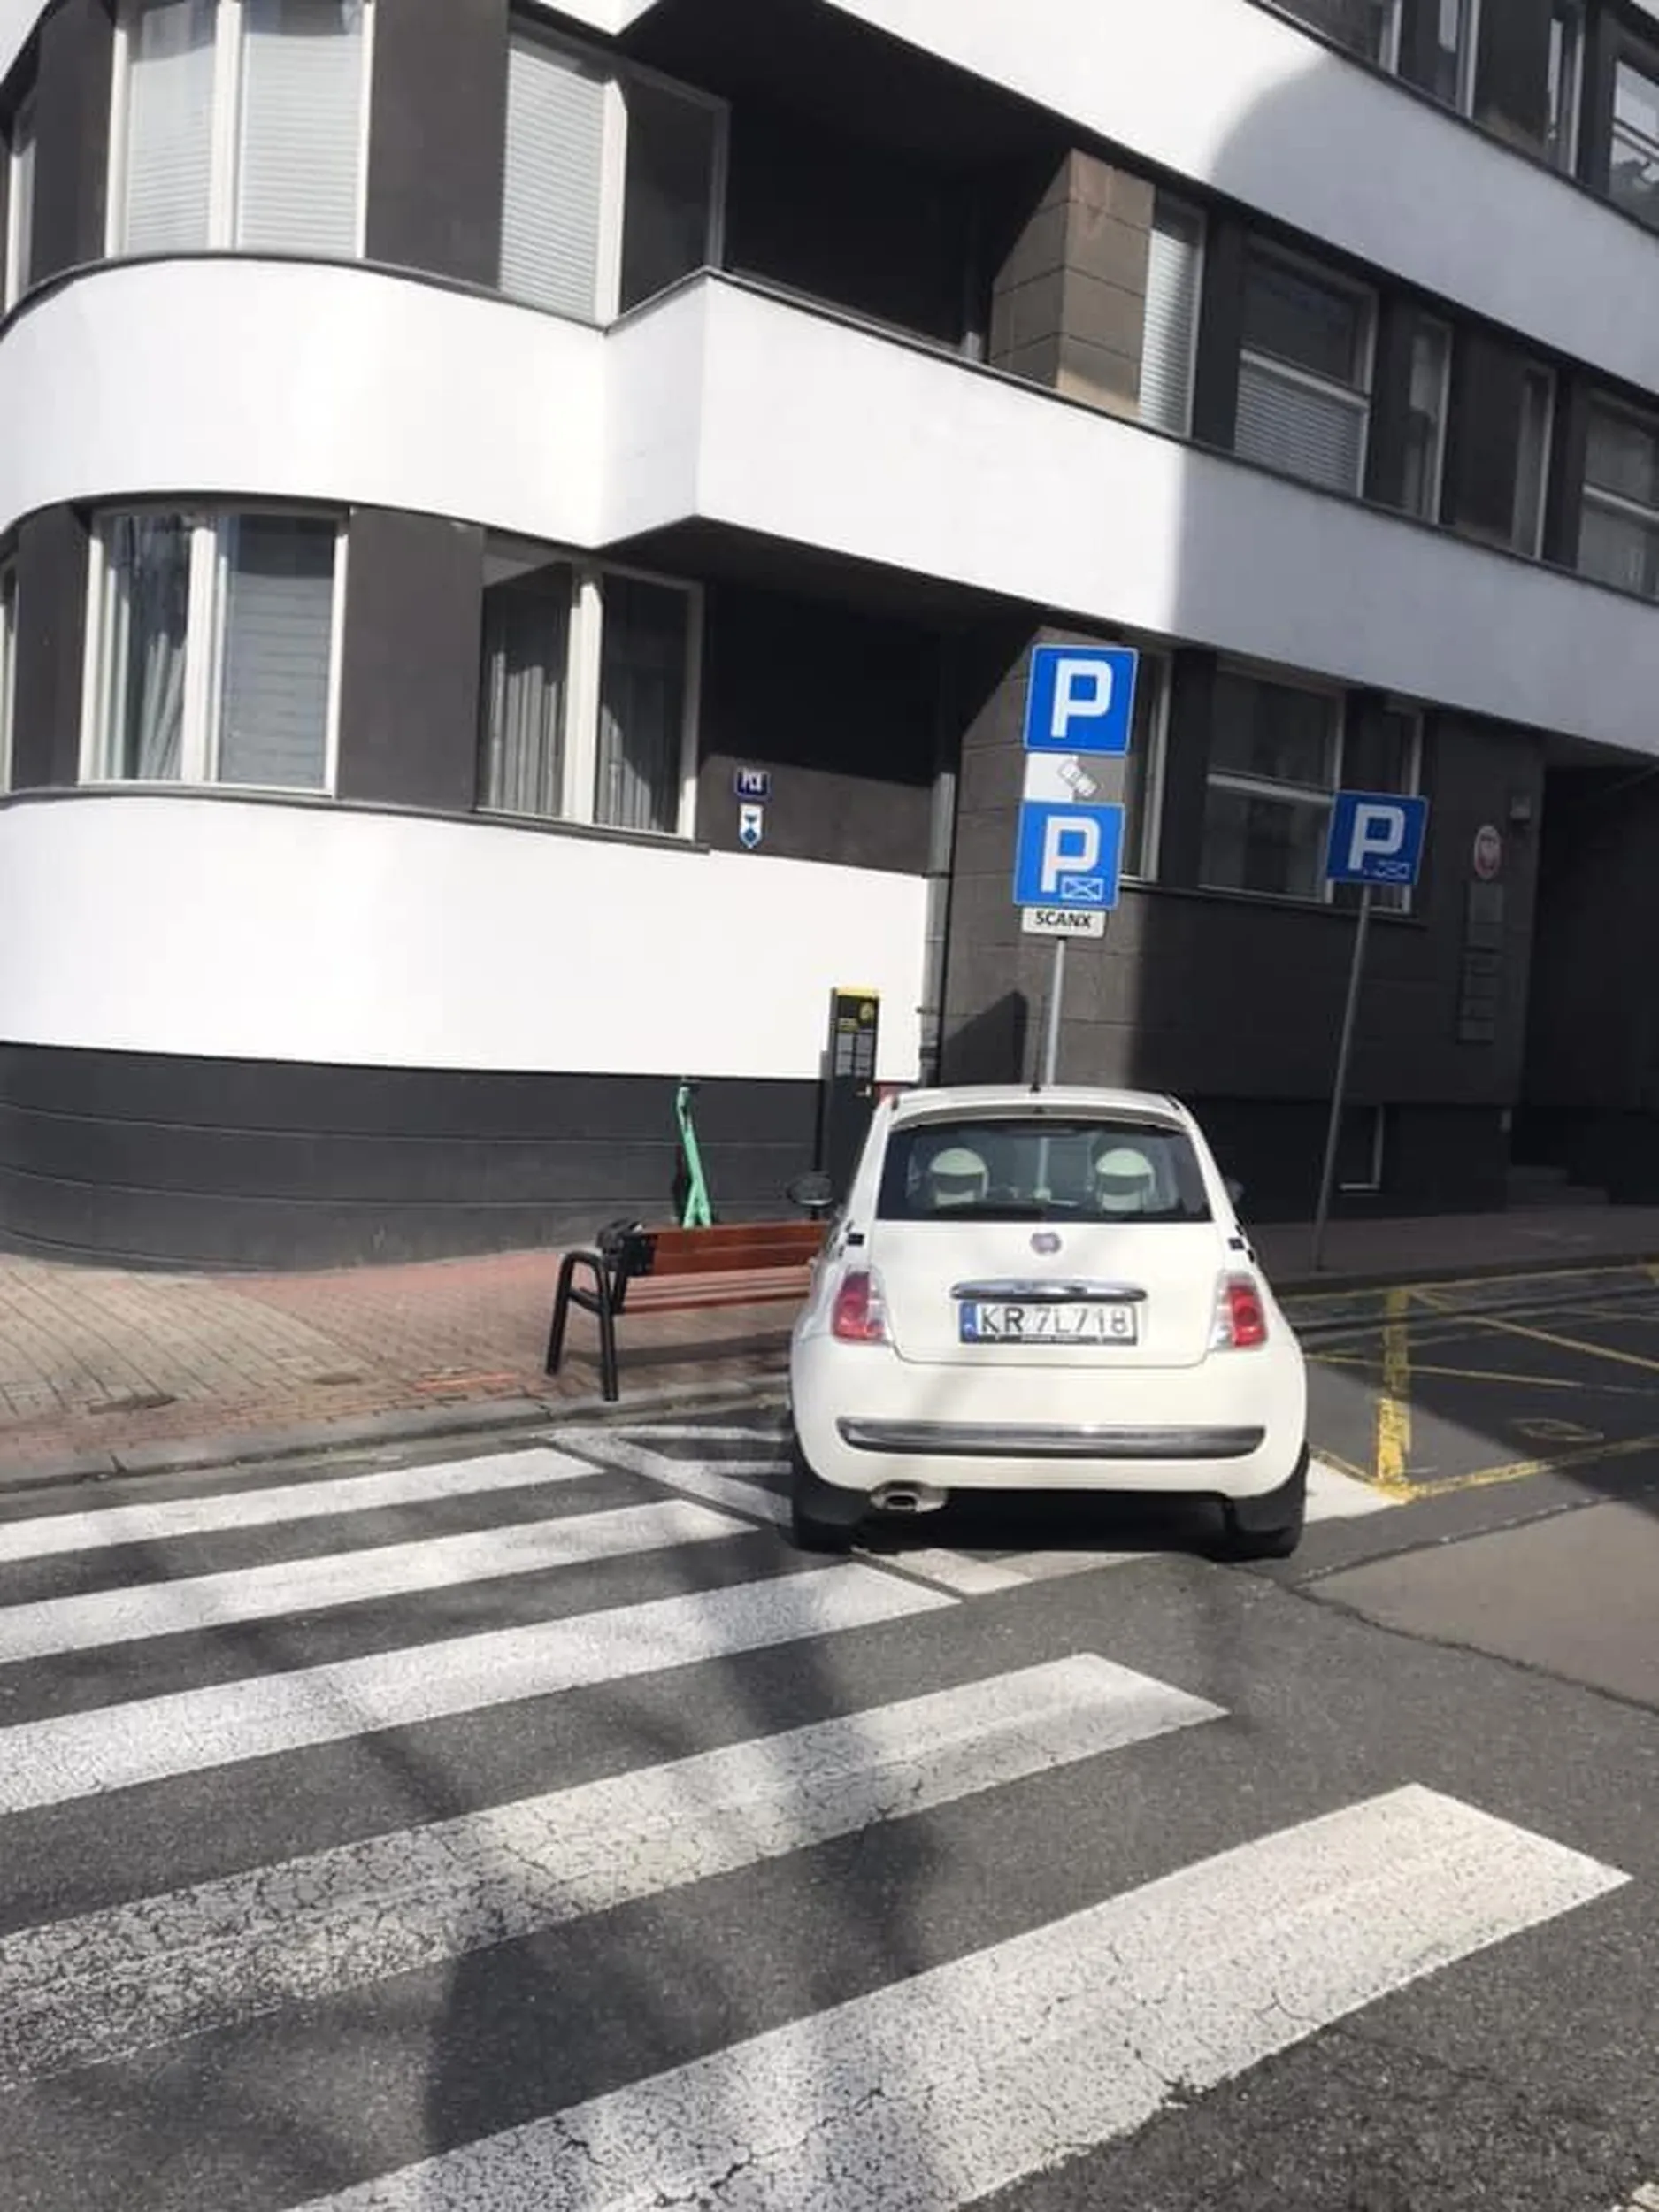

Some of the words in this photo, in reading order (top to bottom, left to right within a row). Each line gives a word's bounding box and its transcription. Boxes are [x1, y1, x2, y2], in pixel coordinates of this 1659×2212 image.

[1051, 658, 1112, 738] P
[1041, 815, 1101, 893] P
[1348, 803, 1405, 871] P
[981, 1307, 1024, 1334] KR
